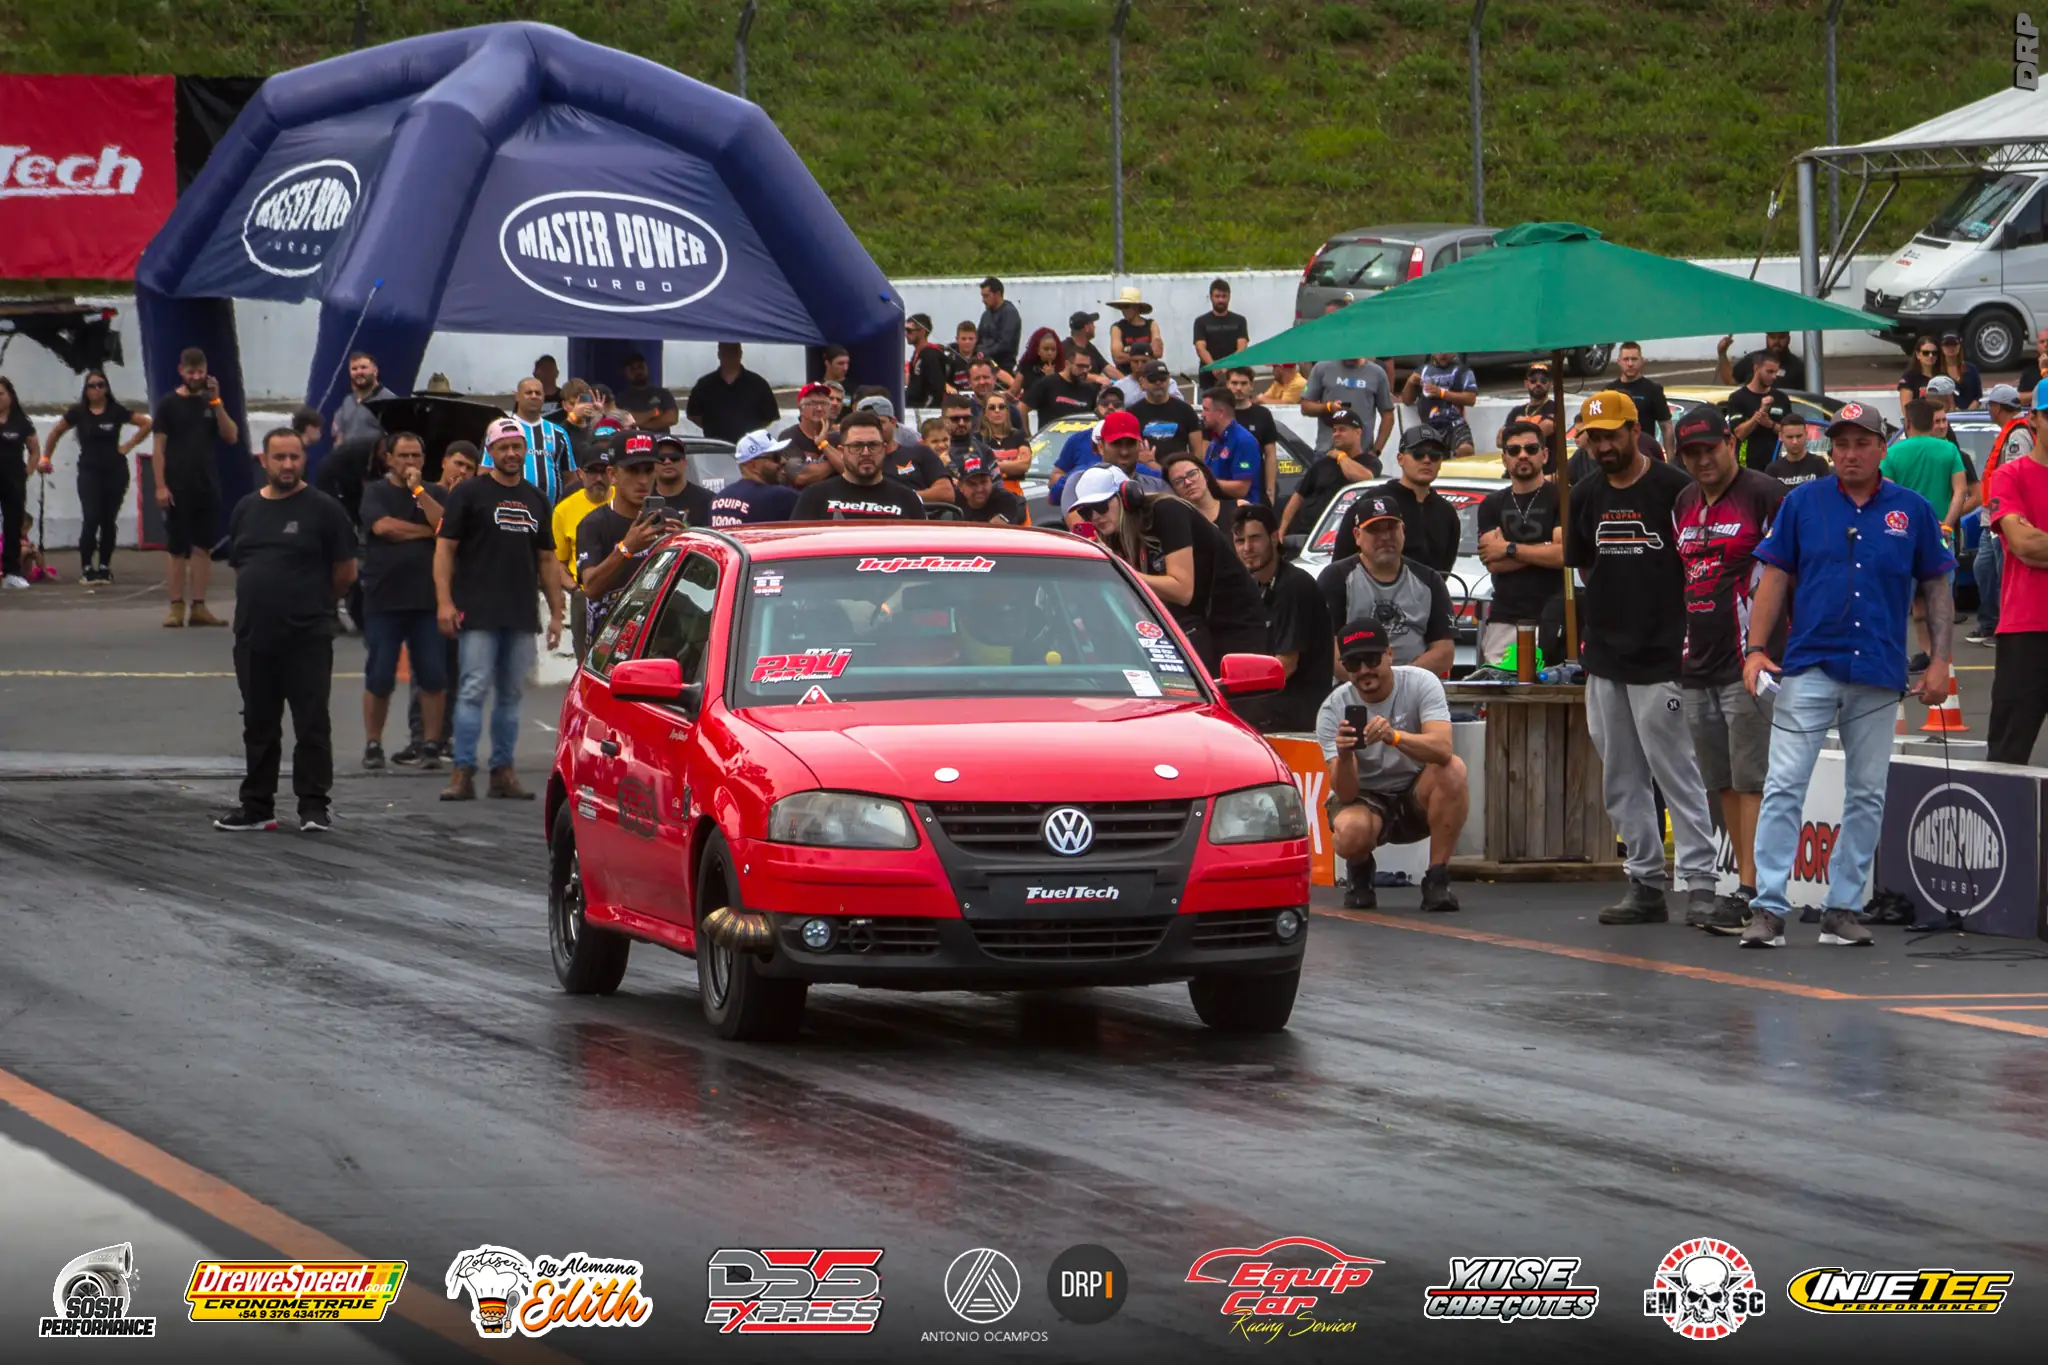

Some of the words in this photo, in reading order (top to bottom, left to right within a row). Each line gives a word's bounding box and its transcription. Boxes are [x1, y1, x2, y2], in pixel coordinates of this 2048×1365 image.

[517, 211, 614, 267] MASTER
[615, 212, 707, 268] POWER
[564, 276, 672, 292] TURBO
[711, 498, 750, 514] EQUIPE
[827, 500, 902, 515] FuelTech
[751, 653, 853, 682] 294
[1291, 772, 1324, 854] K
[1914, 806, 1957, 868] MASTER
[1958, 806, 2000, 870] POWER
[1026, 886, 1120, 900] FuelTech
[1931, 878, 1979, 896] TURBO
